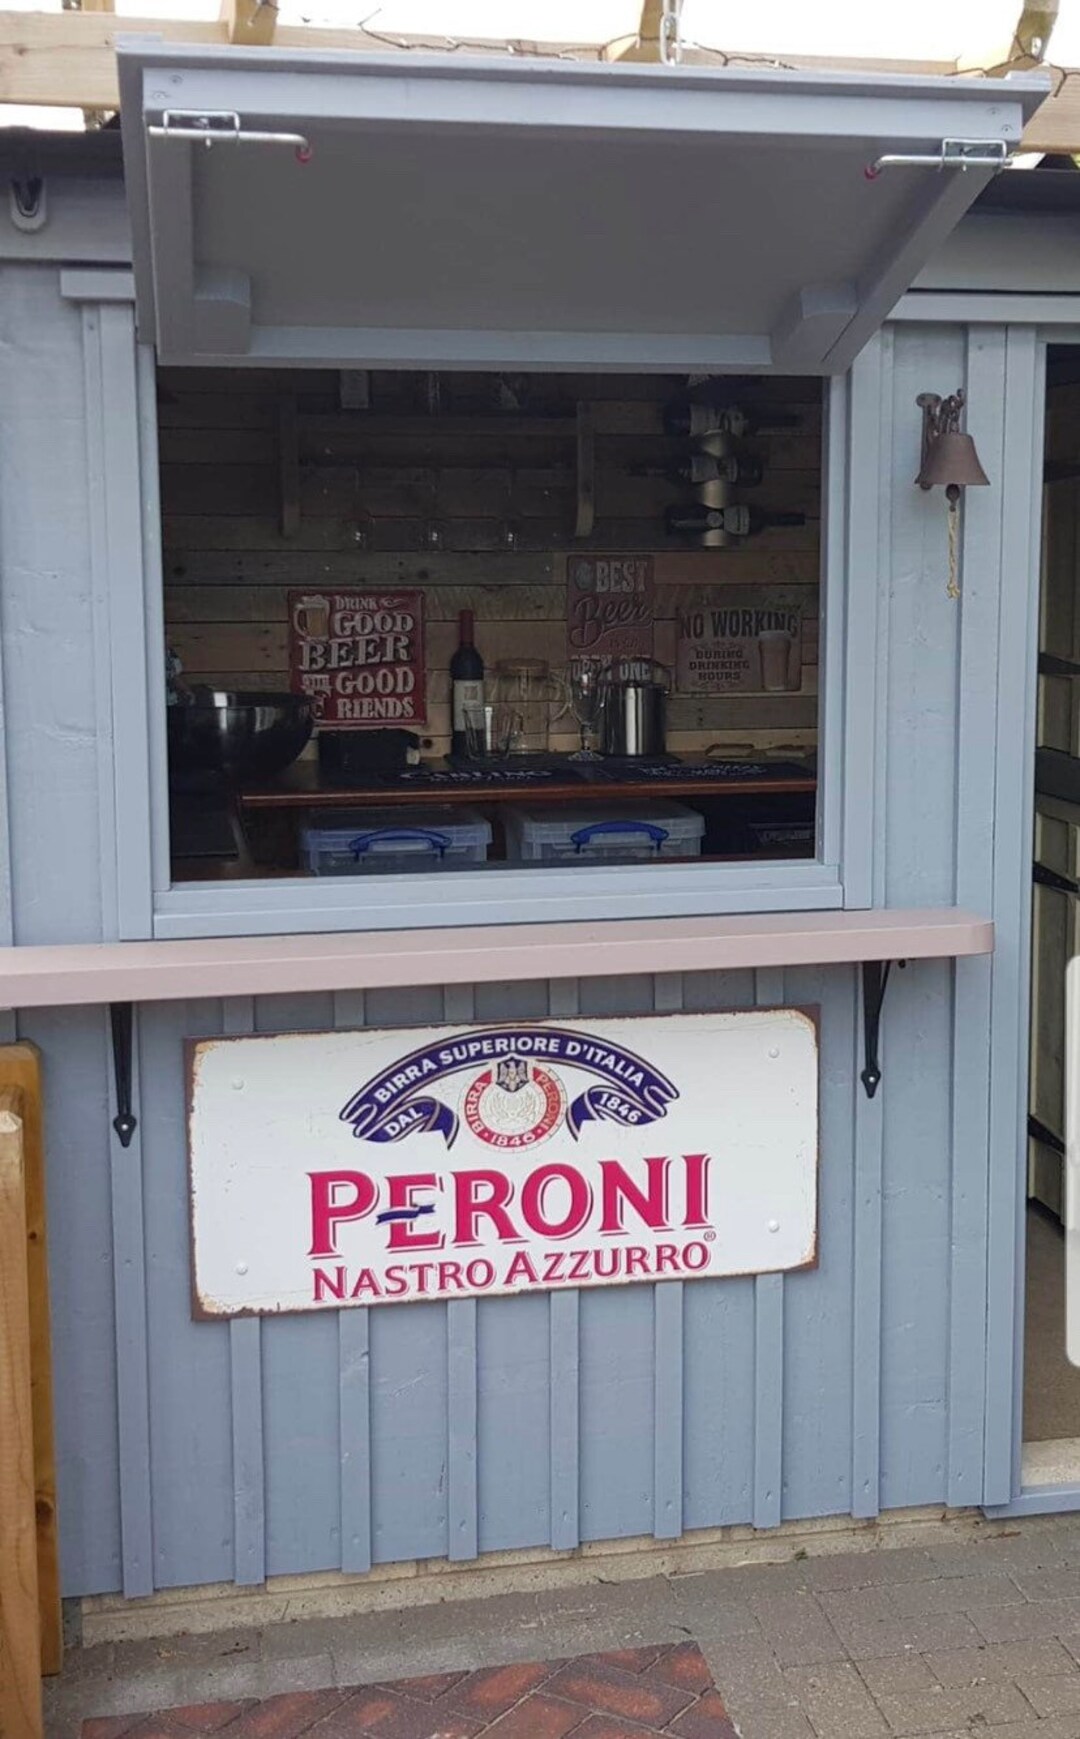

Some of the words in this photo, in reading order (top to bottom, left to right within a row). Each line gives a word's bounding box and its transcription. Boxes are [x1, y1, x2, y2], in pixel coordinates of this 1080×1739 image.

[595, 561, 647, 592] BEST
[335, 596, 378, 610] DRINK
[334, 611, 414, 636] GOOD
[570, 596, 655, 650] Beer
[680, 614, 704, 639] NO
[712, 609, 798, 639] WORKING
[299, 634, 411, 671] BEER
[689, 661, 750, 671] DRINKING
[696, 650, 743, 660] DURING
[336, 667, 415, 694] GOOD
[698, 672, 741, 681] HOURS
[374, 1058, 438, 1104] BIRRA
[440, 1036, 560, 1066] SUPERIORE
[566, 1043, 645, 1088] D'ITALIA
[383, 1106, 423, 1138] DAL
[599, 1091, 643, 1124] 1846
[465, 1080, 486, 1133] BIRRA
[535, 1073, 560, 1131] PERONI
[490, 1132, 537, 1148] 1846
[307, 1153, 713, 1260] PERONI
[312, 1258, 496, 1302] NASTRO
[503, 1240, 711, 1285] AZZURRO
